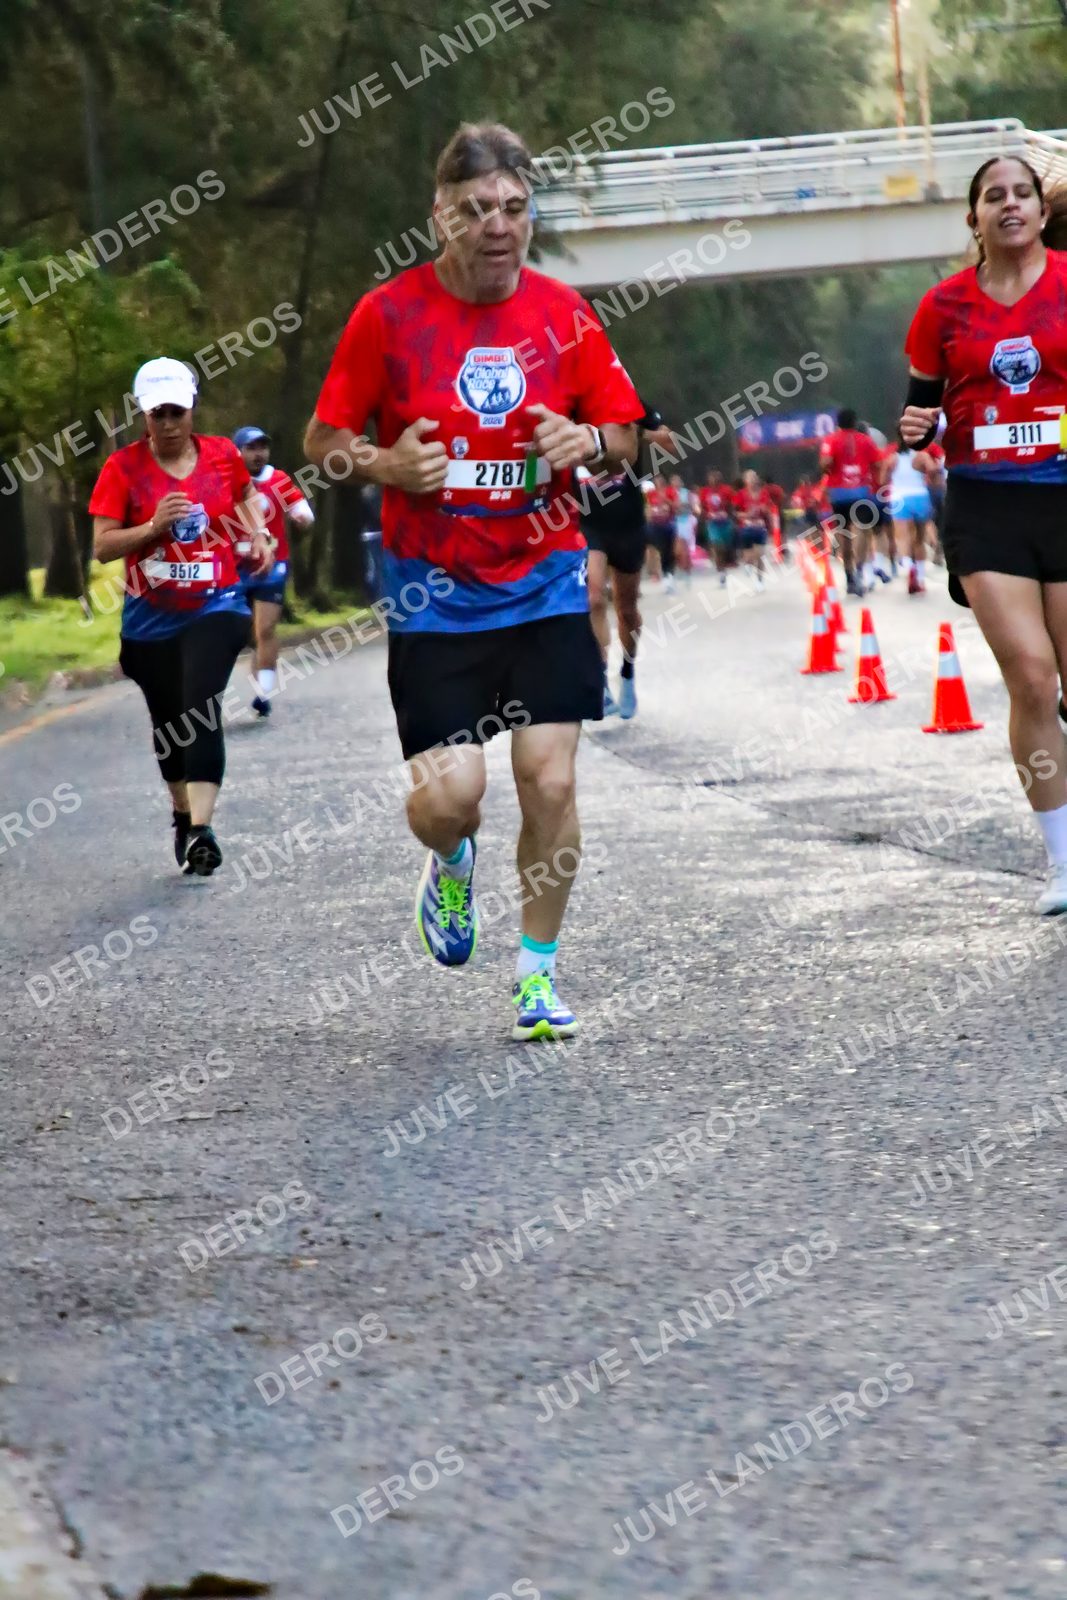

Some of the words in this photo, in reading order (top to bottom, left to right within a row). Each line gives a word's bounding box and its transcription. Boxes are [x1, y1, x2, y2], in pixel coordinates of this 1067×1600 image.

[1008, 424, 1042, 445] 3111
[475, 462, 525, 486] 2787
[169, 563, 201, 579] 3512
